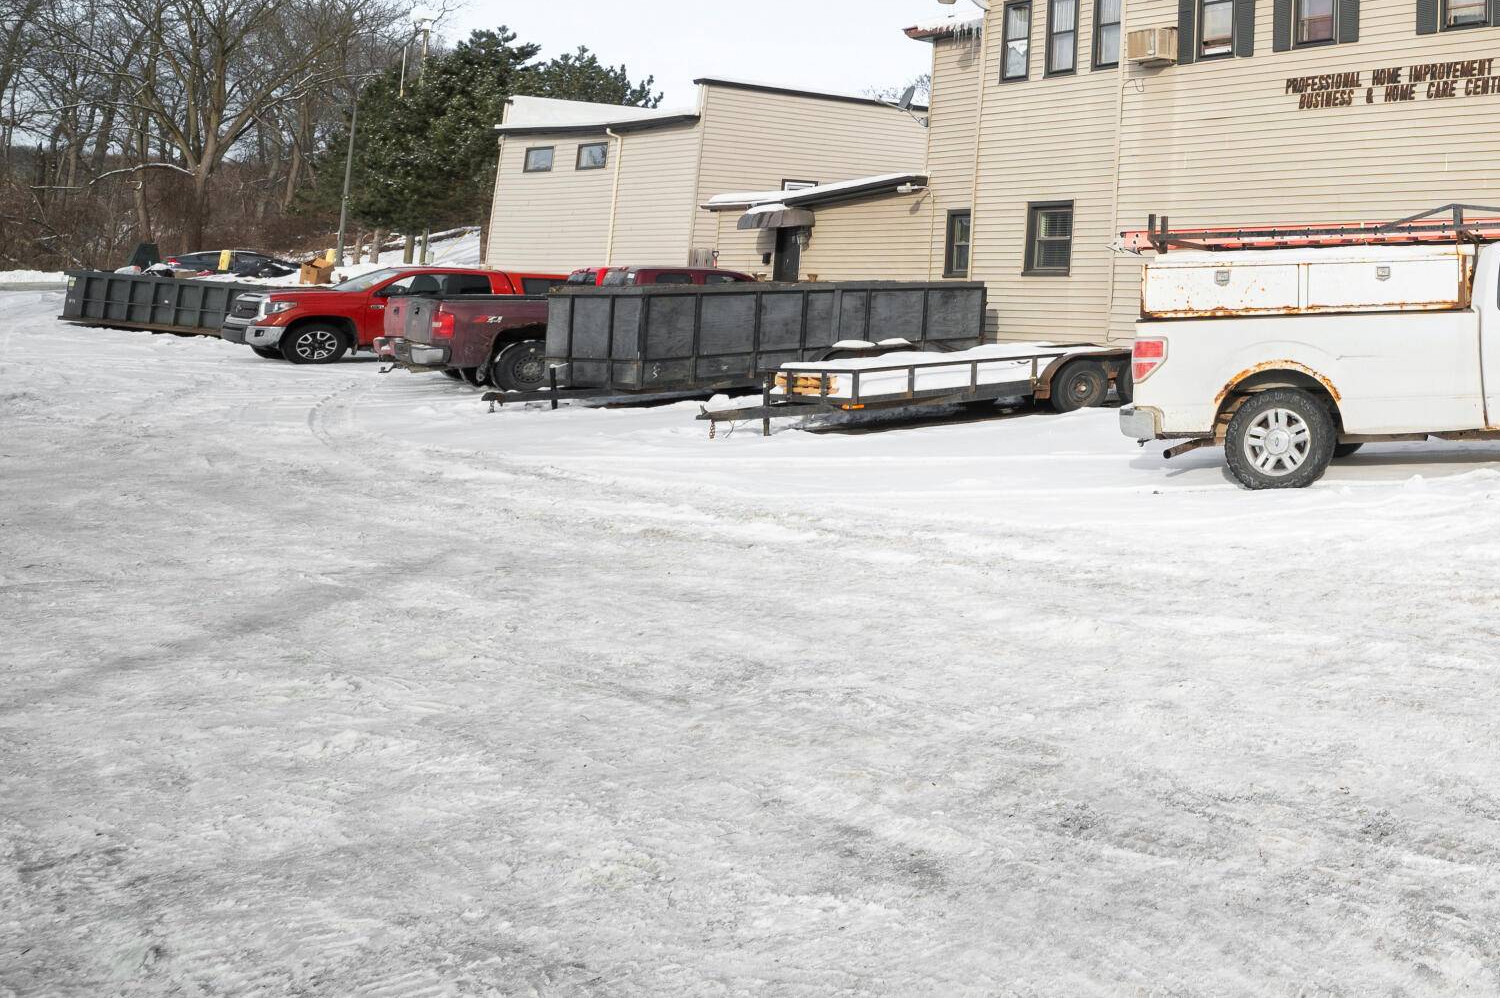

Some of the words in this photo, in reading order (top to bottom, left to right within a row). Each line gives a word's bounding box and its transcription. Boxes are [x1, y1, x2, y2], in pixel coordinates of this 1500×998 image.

[1285, 72, 1361, 94] PROFESSIONAL
[1372, 67, 1402, 86] HOME
[1409, 58, 1494, 82] IMPROVEMENT
[1299, 89, 1354, 109] BUSINESS
[1366, 87, 1373, 103] &
[1384, 84, 1417, 102] HOME
[1426, 80, 1458, 99] CARE
